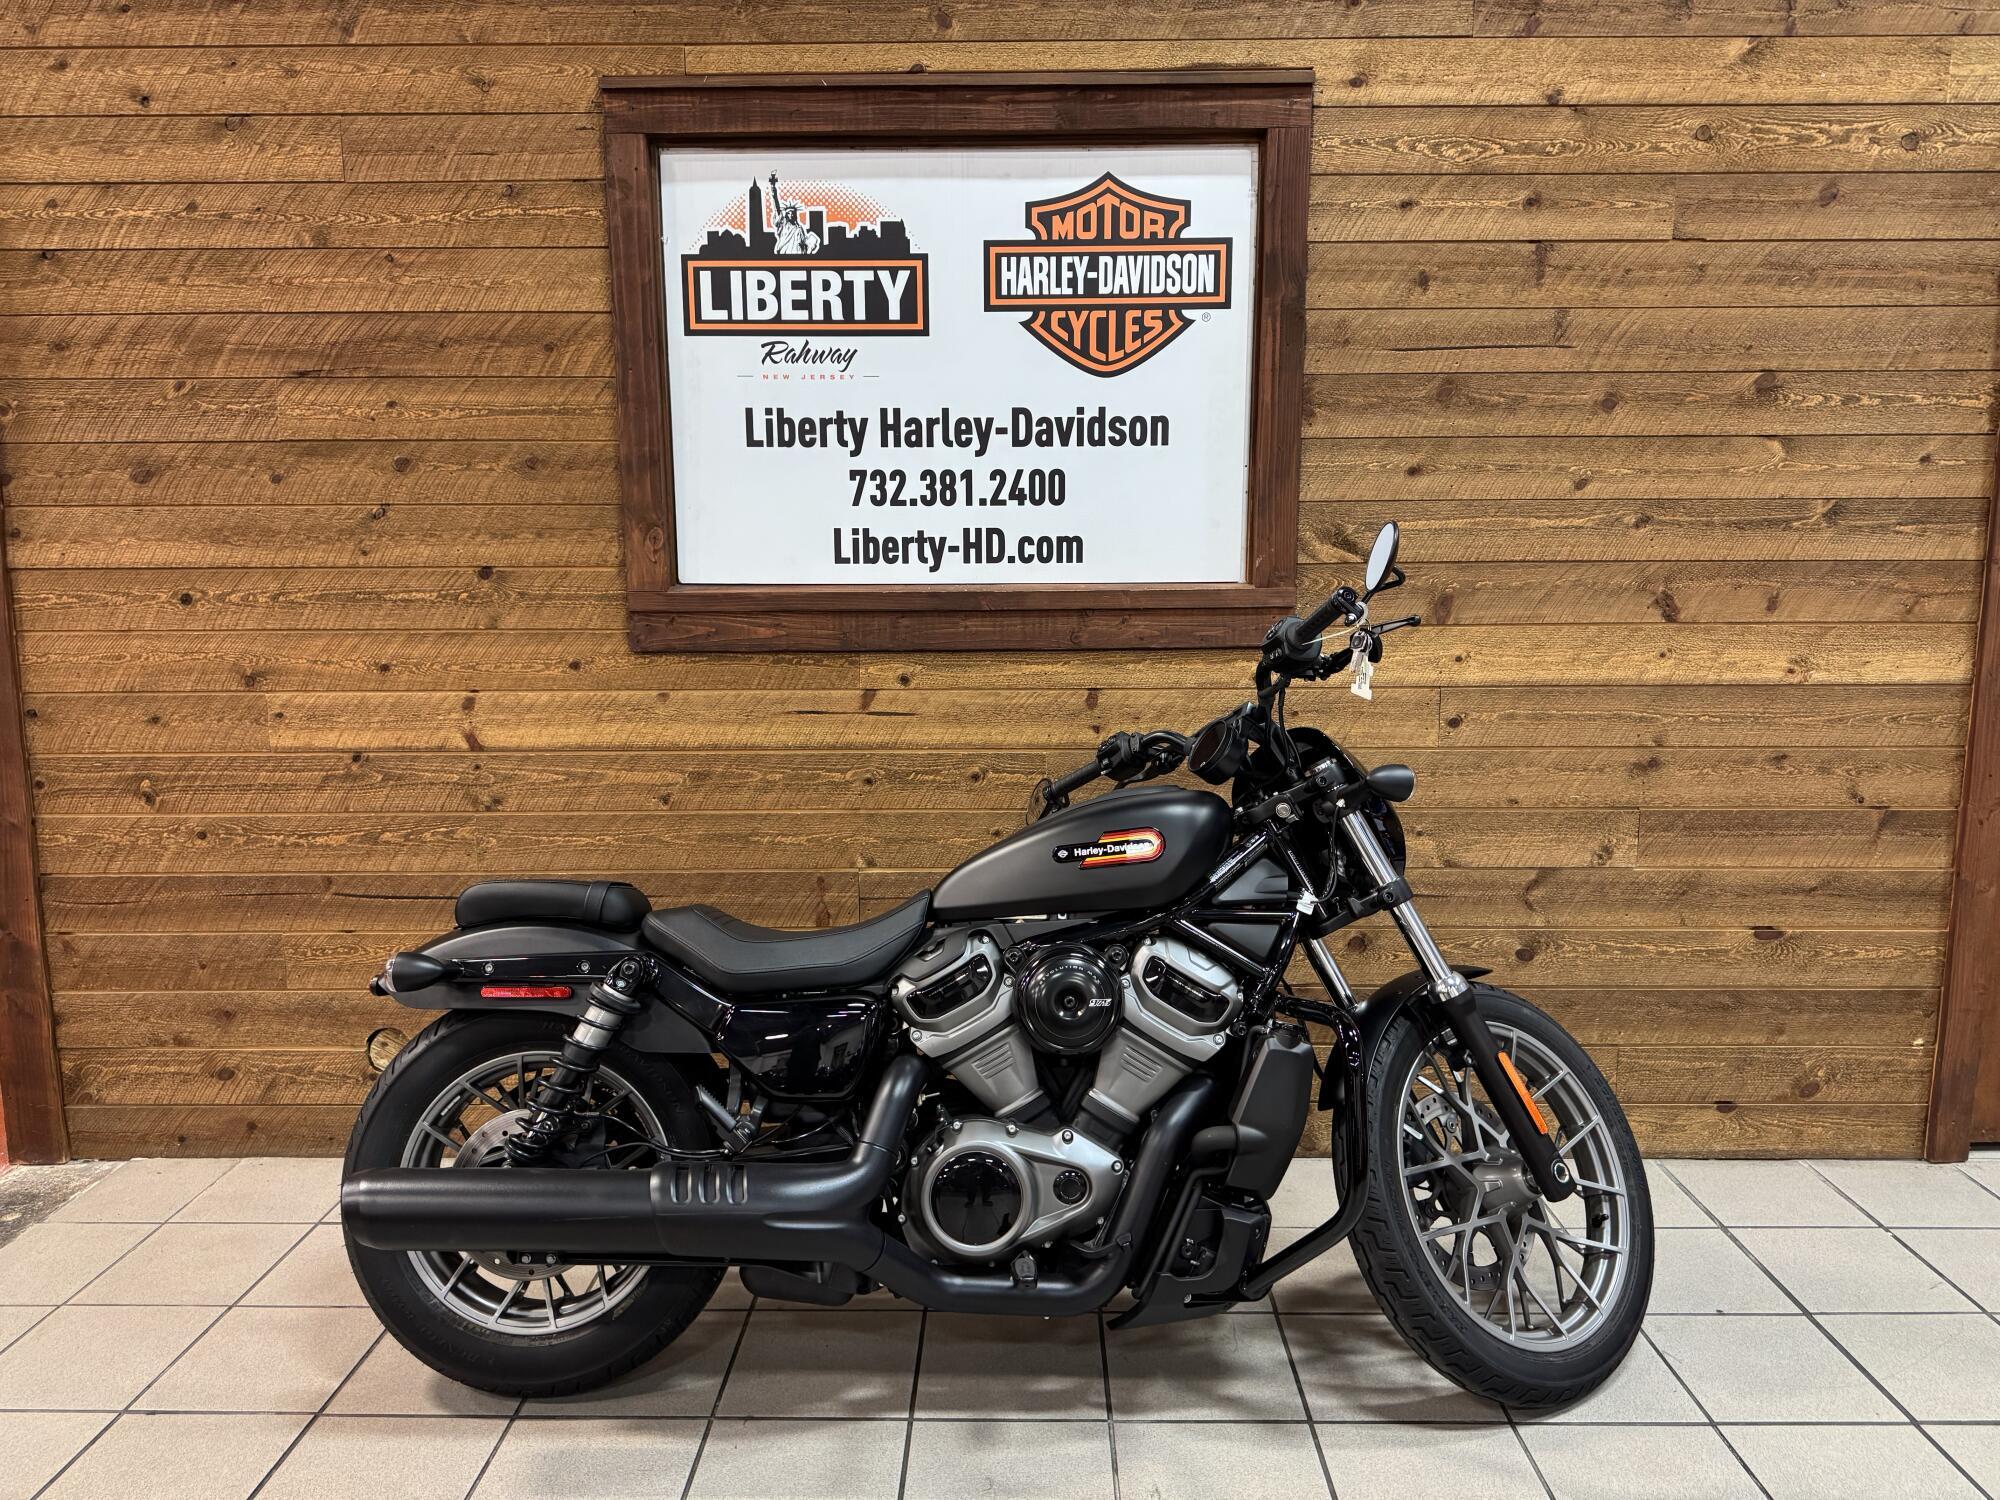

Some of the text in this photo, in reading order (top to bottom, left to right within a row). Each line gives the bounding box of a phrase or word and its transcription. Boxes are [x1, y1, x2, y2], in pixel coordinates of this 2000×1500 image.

[1052, 193, 1165, 241] MOTOR
[699, 270, 911, 321] LIBERTY
[1000, 253, 1215, 296] HARLEY-DAVIDSON
[760, 339, 858, 373] Rahway
[1050, 309, 1163, 362] CYCLES
[745, 406, 1170, 458] Liberty Harley-Davidson
[848, 468, 1066, 507] 732.381.2400
[833, 526, 1084, 573] Liberty-HD.com
